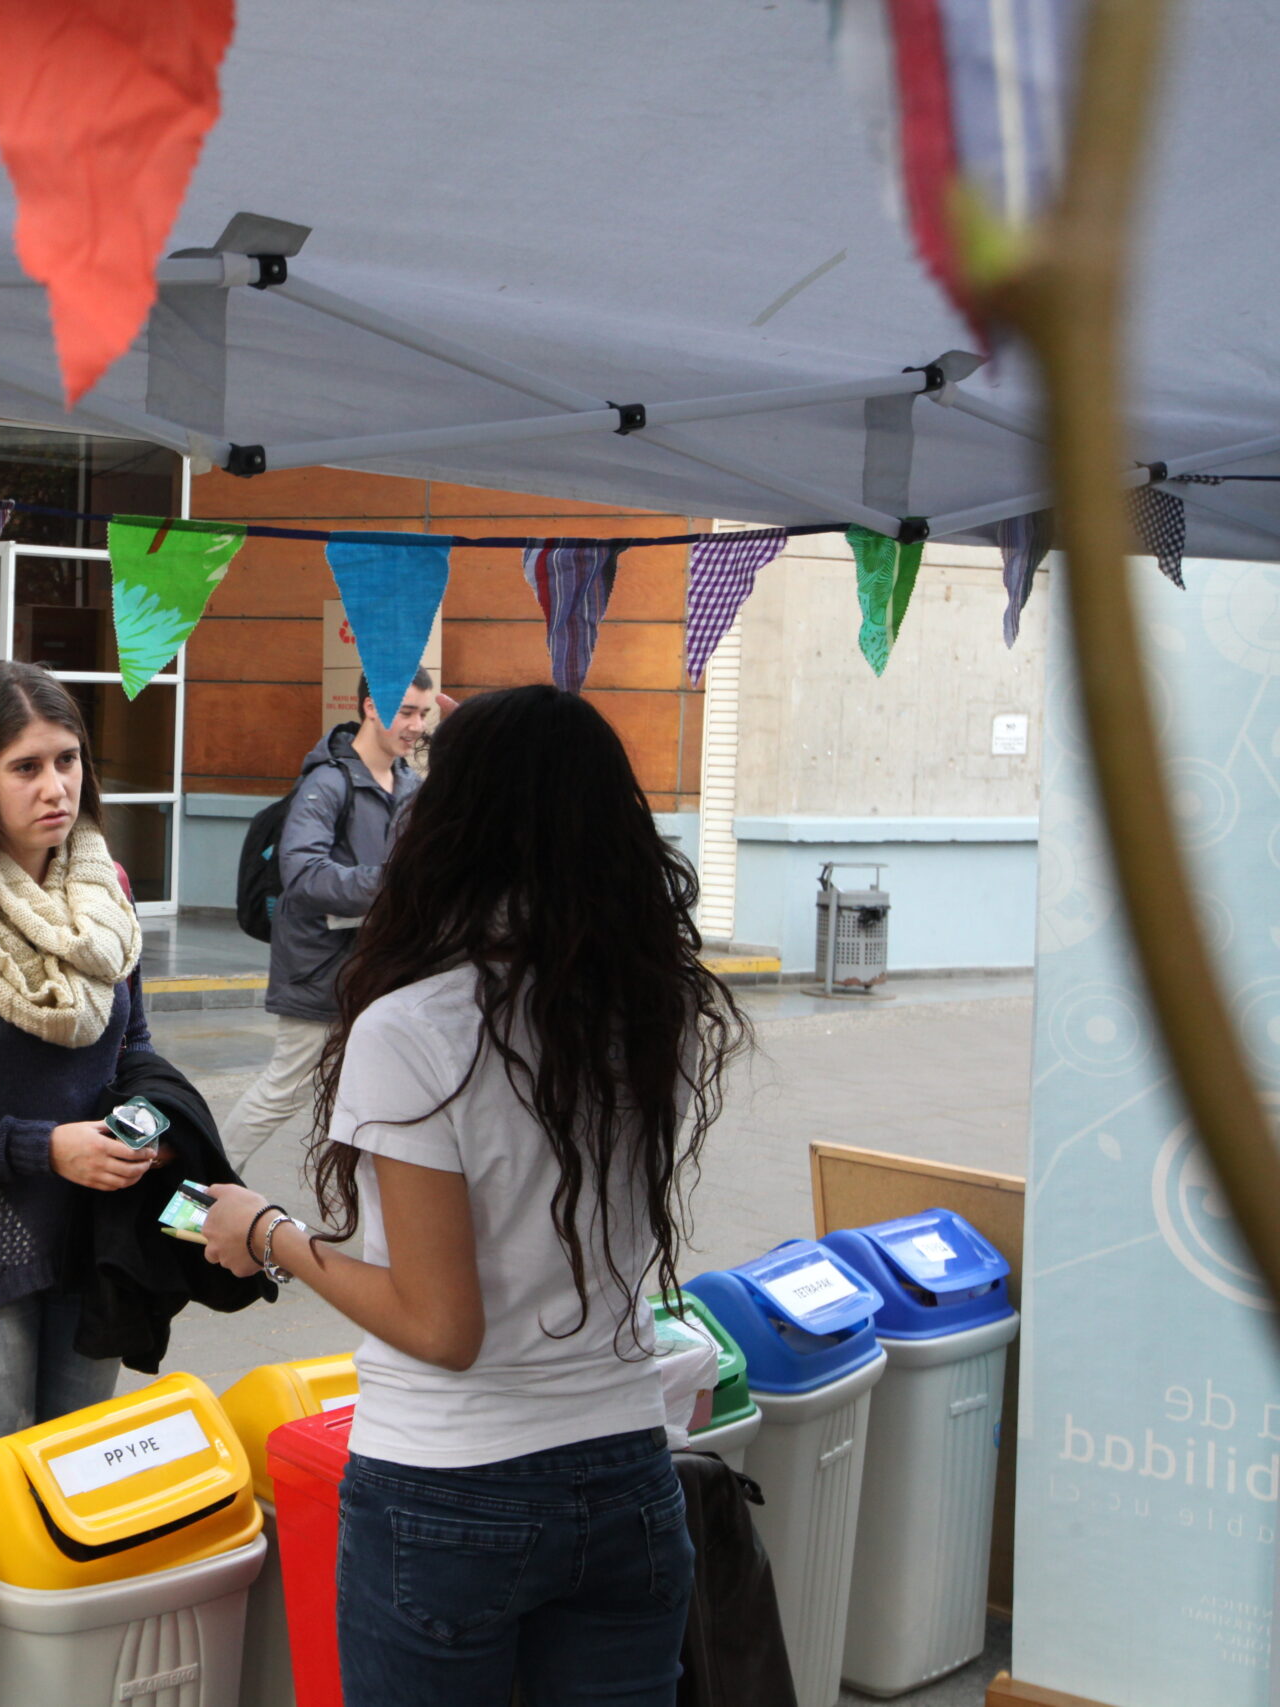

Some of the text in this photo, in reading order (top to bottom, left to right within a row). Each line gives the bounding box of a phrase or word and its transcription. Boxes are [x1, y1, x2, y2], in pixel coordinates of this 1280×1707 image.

[104, 1437, 160, 1466] PP Y PE
